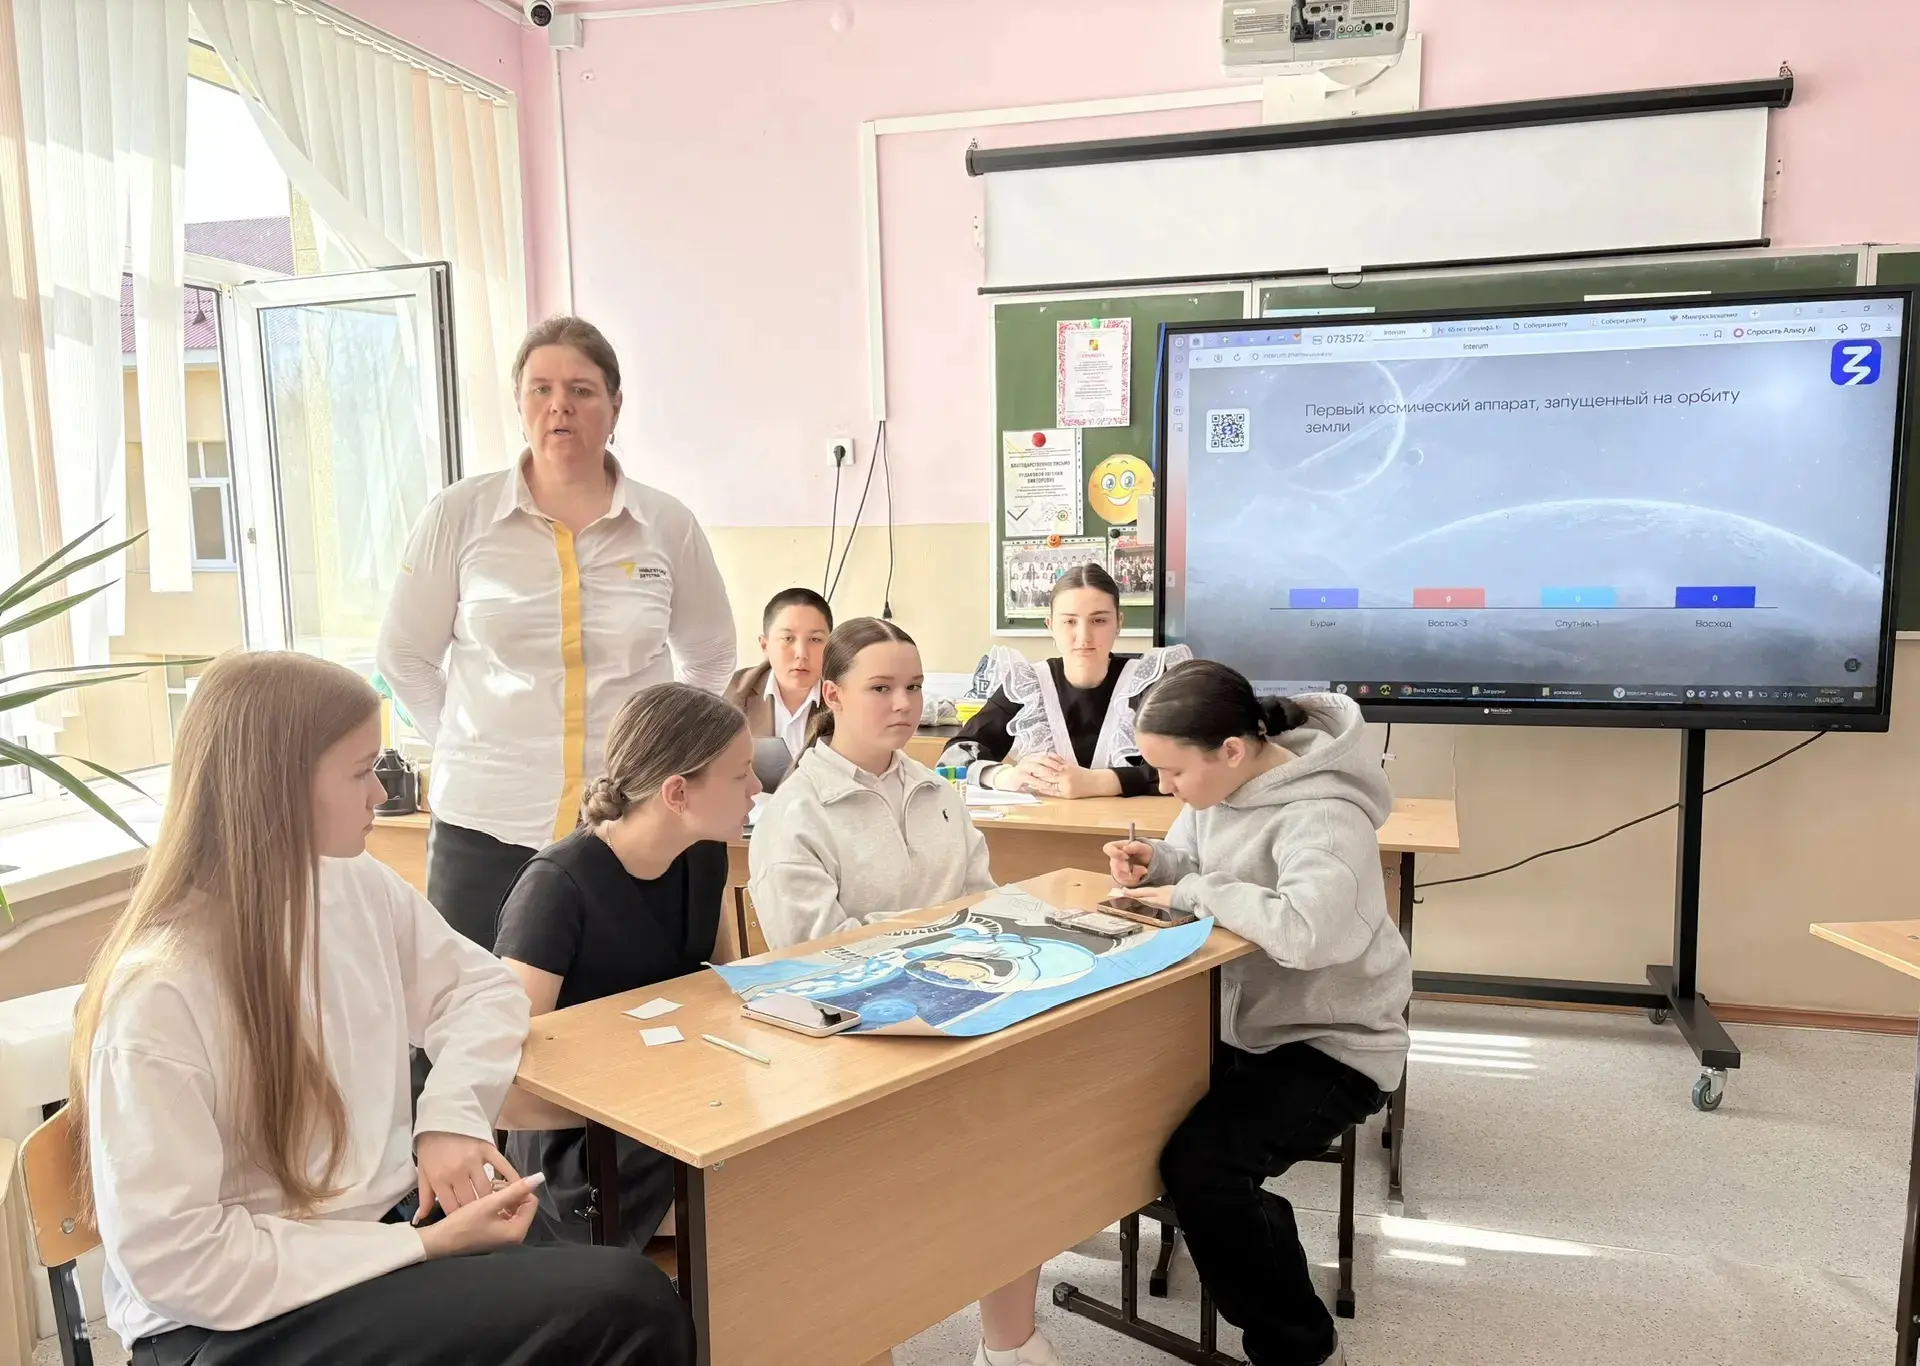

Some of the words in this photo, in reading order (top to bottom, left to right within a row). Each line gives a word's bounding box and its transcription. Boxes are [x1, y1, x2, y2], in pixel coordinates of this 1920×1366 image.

[1747, 328, 1782, 336] Спросить
[1326, 333, 1365, 344] 073572
[1305, 402, 1365, 418] Первый
[1369, 399, 1470, 414] космический
[1474, 399, 1540, 412] аппарат,
[1544, 390, 1648, 411] запущенный
[1653, 394, 1673, 404] на
[1677, 387, 1740, 406] орбиту
[1305, 422, 1351, 434] земли
[1310, 619, 1336, 628] Буран
[1428, 619, 1467, 627] Восток-3
[1555, 619, 1600, 628] Спутник-1
[1696, 619, 1732, 628] Восход
